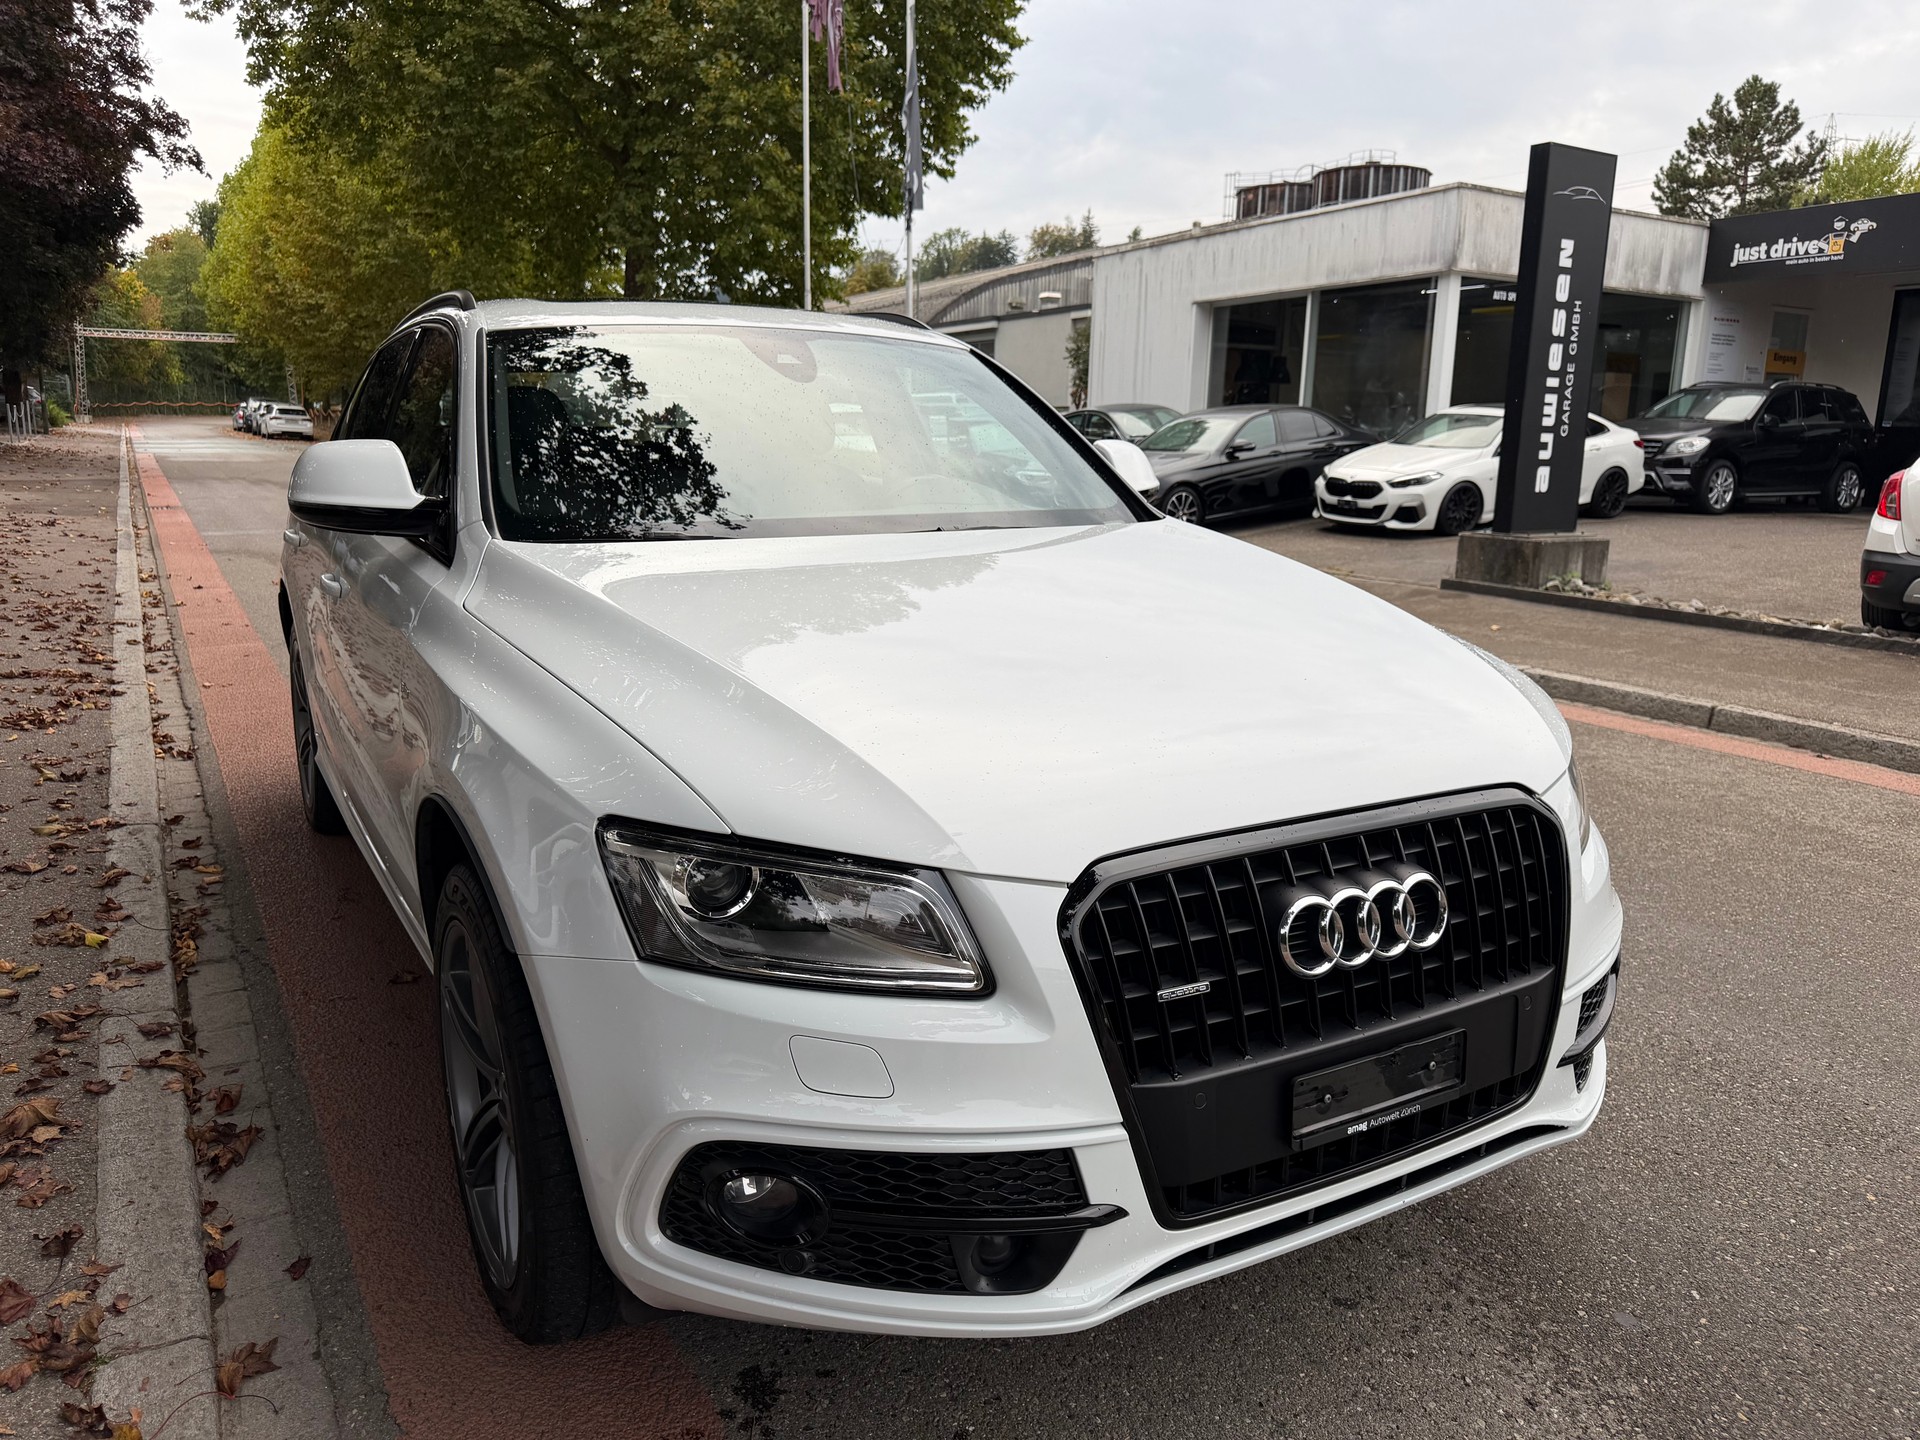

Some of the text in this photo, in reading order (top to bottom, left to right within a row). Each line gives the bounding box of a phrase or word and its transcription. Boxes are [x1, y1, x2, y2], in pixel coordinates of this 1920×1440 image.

[1730, 243, 1768, 267] just
[1492, 290, 1507, 301] AUTO
[1560, 300, 1582, 437] GARAGE GMBH
[1162, 985, 1207, 999] quattro
[1347, 1104, 1421, 1135] amag Autowelt Zürich
